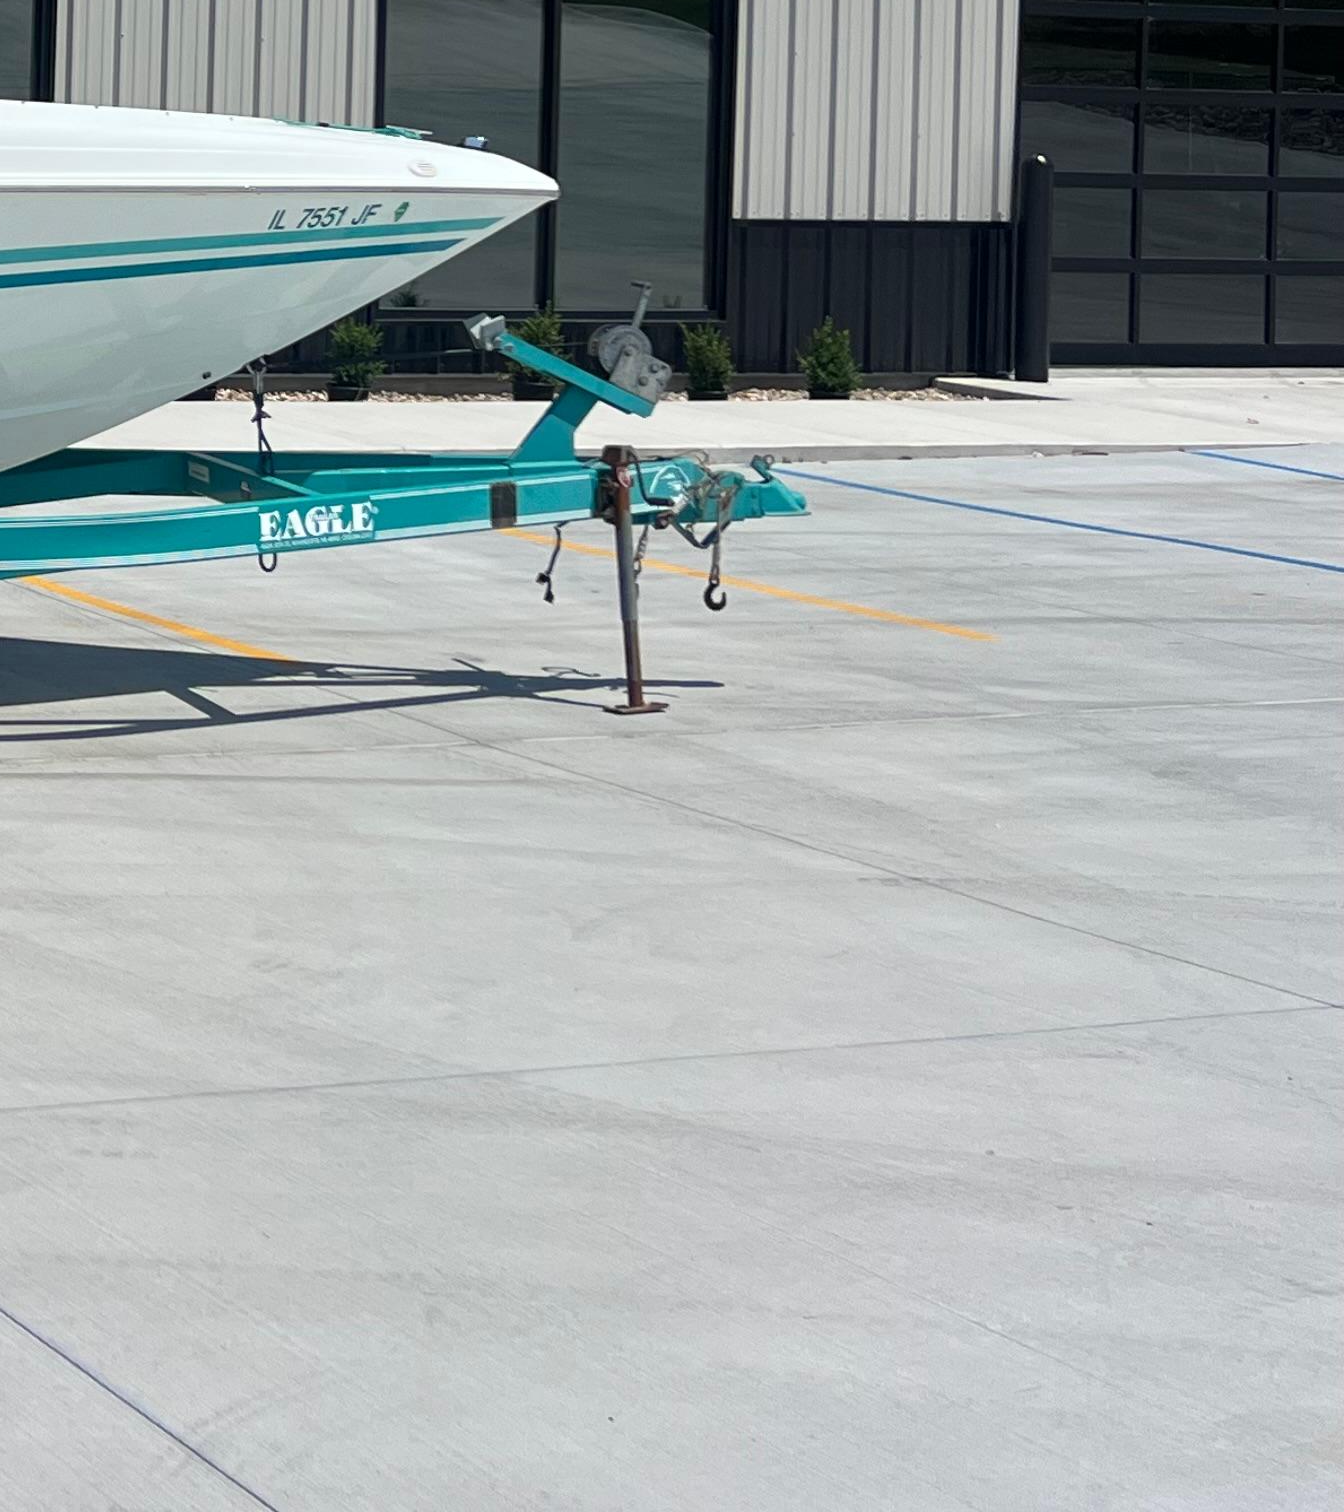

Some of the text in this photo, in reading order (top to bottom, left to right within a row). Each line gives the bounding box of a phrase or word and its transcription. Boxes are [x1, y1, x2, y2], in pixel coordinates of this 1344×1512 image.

[267, 203, 383, 231] IL 7551 JF
[258, 501, 374, 542] EAGLE
